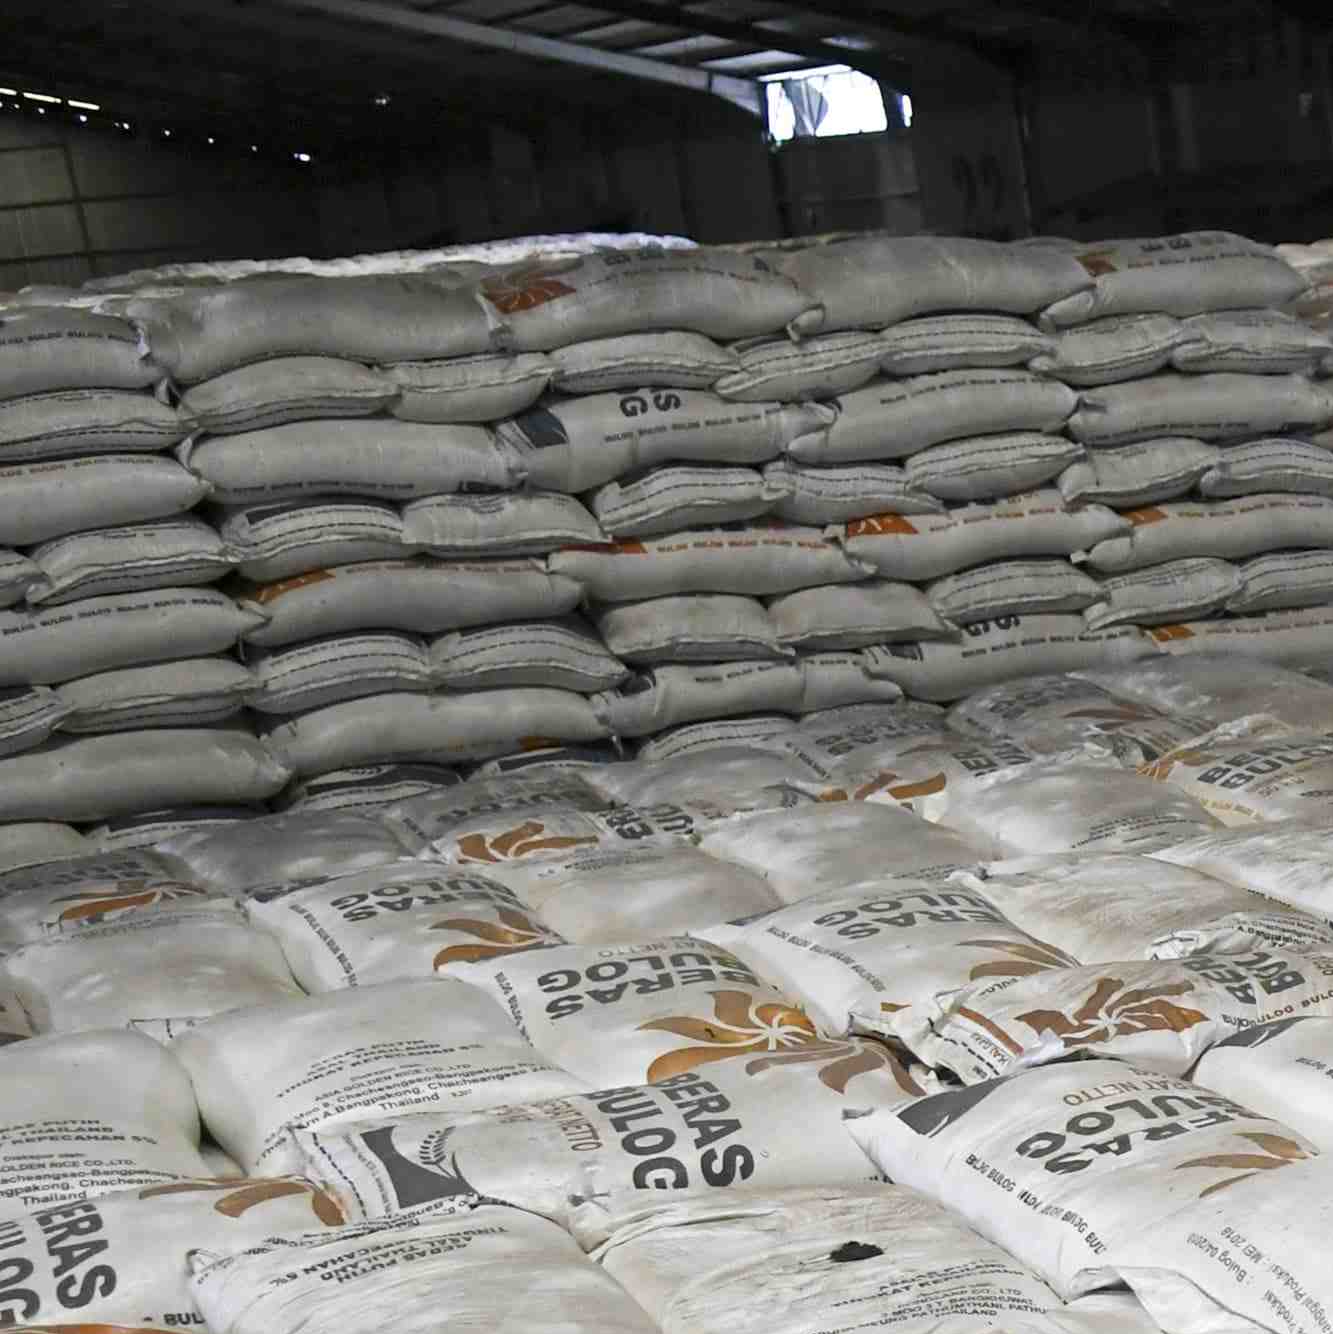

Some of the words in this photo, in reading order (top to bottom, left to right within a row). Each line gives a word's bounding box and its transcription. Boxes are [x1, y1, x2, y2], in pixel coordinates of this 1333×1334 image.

[546, 966, 761, 1021] BERAS
[379, 1092, 441, 1112] Thailand
[583, 1087, 689, 1191] BULOG
[655, 1071, 755, 1188] BERAS
[23, 1190, 88, 1206] Thailand
[1217, 1250, 1248, 1284] Bulog
[163, 1312, 206, 1327] BUL
